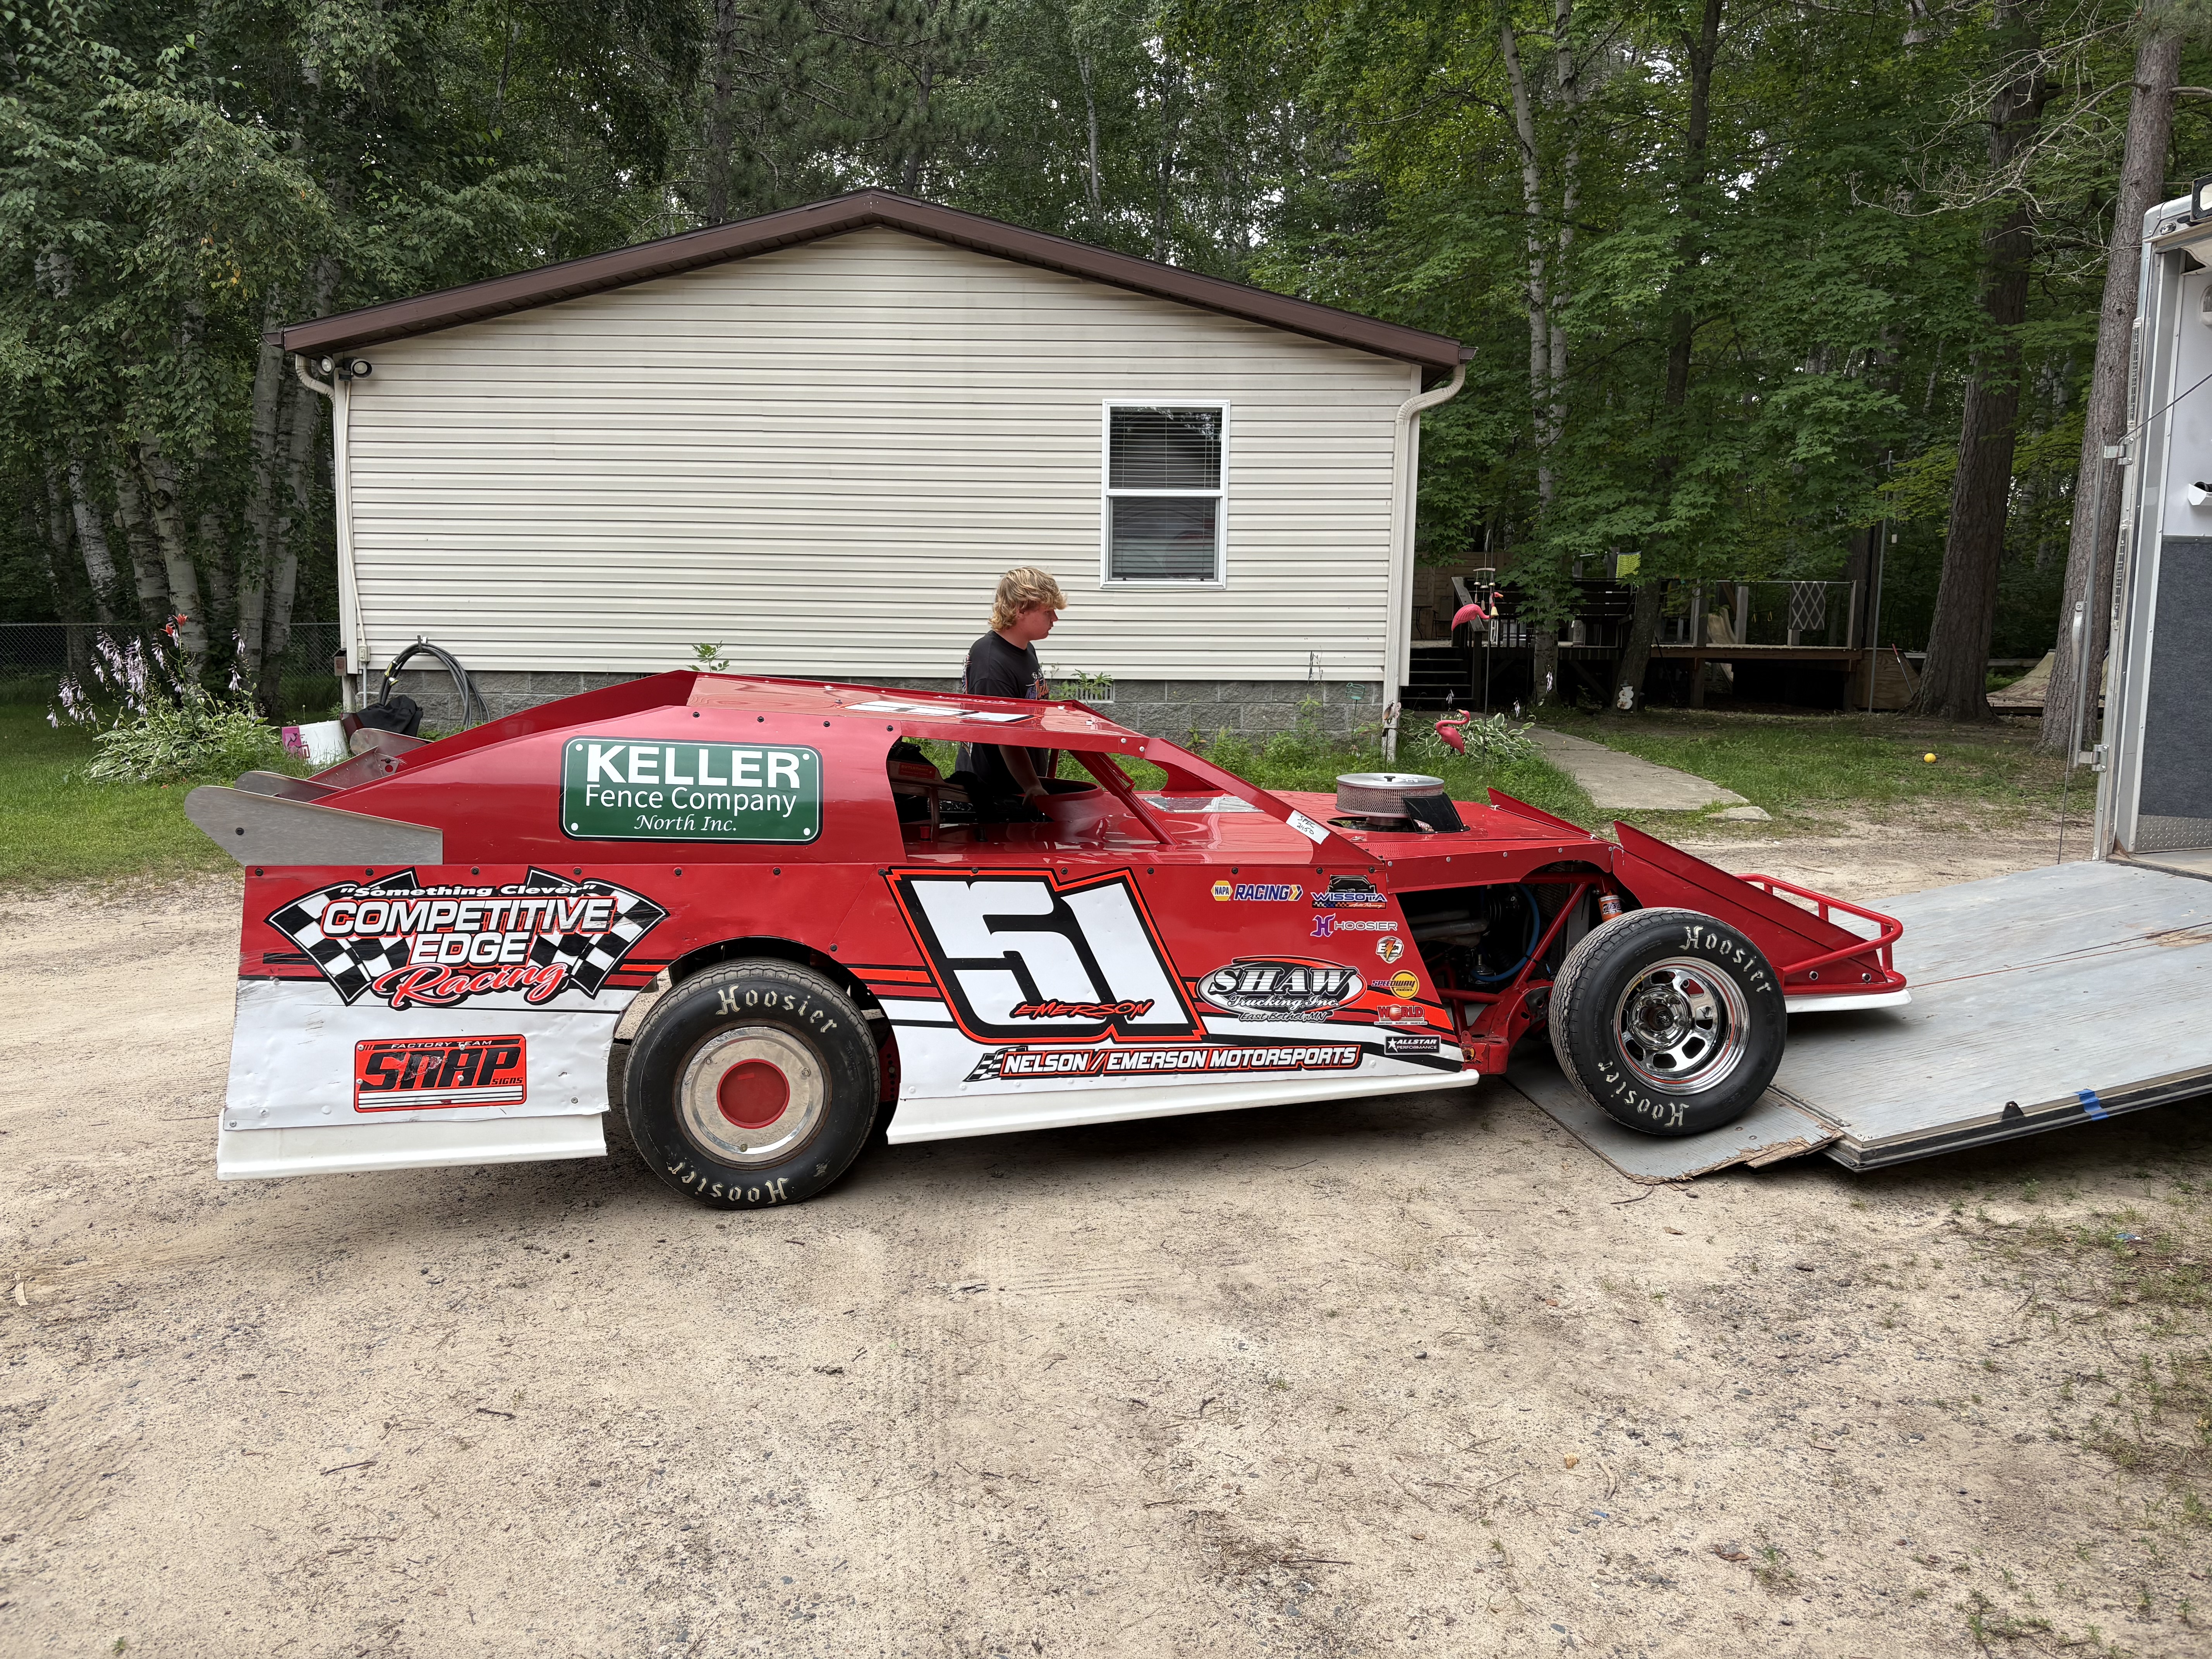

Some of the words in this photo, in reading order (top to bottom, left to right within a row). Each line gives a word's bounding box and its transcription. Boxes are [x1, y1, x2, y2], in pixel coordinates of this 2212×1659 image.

[586, 744, 800, 789] KELLER
[586, 784, 663, 808] Fence
[671, 787, 797, 818] Company
[634, 814, 695, 831] North
[700, 816, 737, 831] Inc.
[1297, 816, 1316, 828] SPEC
[339, 885, 493, 897] "Something
[500, 884, 597, 895] Clever"
[1214, 886, 1230, 895] NAPA
[1234, 884, 1290, 900] RACING
[1310, 892, 1388, 902] WISSOTA
[325, 898, 614, 935] COMPETITIVE
[1334, 921, 1398, 931] HOOSIER
[409, 932, 532, 964] EDGE
[910, 880, 1189, 1025] 51
[1679, 926, 1772, 993] Hoosier
[372, 962, 568, 1008] Racing
[1208, 968, 1355, 994] SHAW
[1371, 980, 1416, 988] SPEEDWAY
[715, 984, 837, 1033] Hoosier
[1013, 1001, 1153, 1019] EMERSON
[1304, 995, 1340, 1007] Inc.
[1377, 1004, 1424, 1020] WORLD
[1269, 1012, 1307, 1022] Bethel,
[1307, 1012, 1328, 1020] MN
[359, 1046, 522, 1091] SNAP
[1005, 1053, 1087, 1073] NELSON
[1106, 1051, 1206, 1071] EMERSON
[1209, 1047, 1358, 1068] MOTORSPORTS
[1598, 1060, 1690, 1127] Hoosier
[666, 1161, 790, 1204] Hoosier
